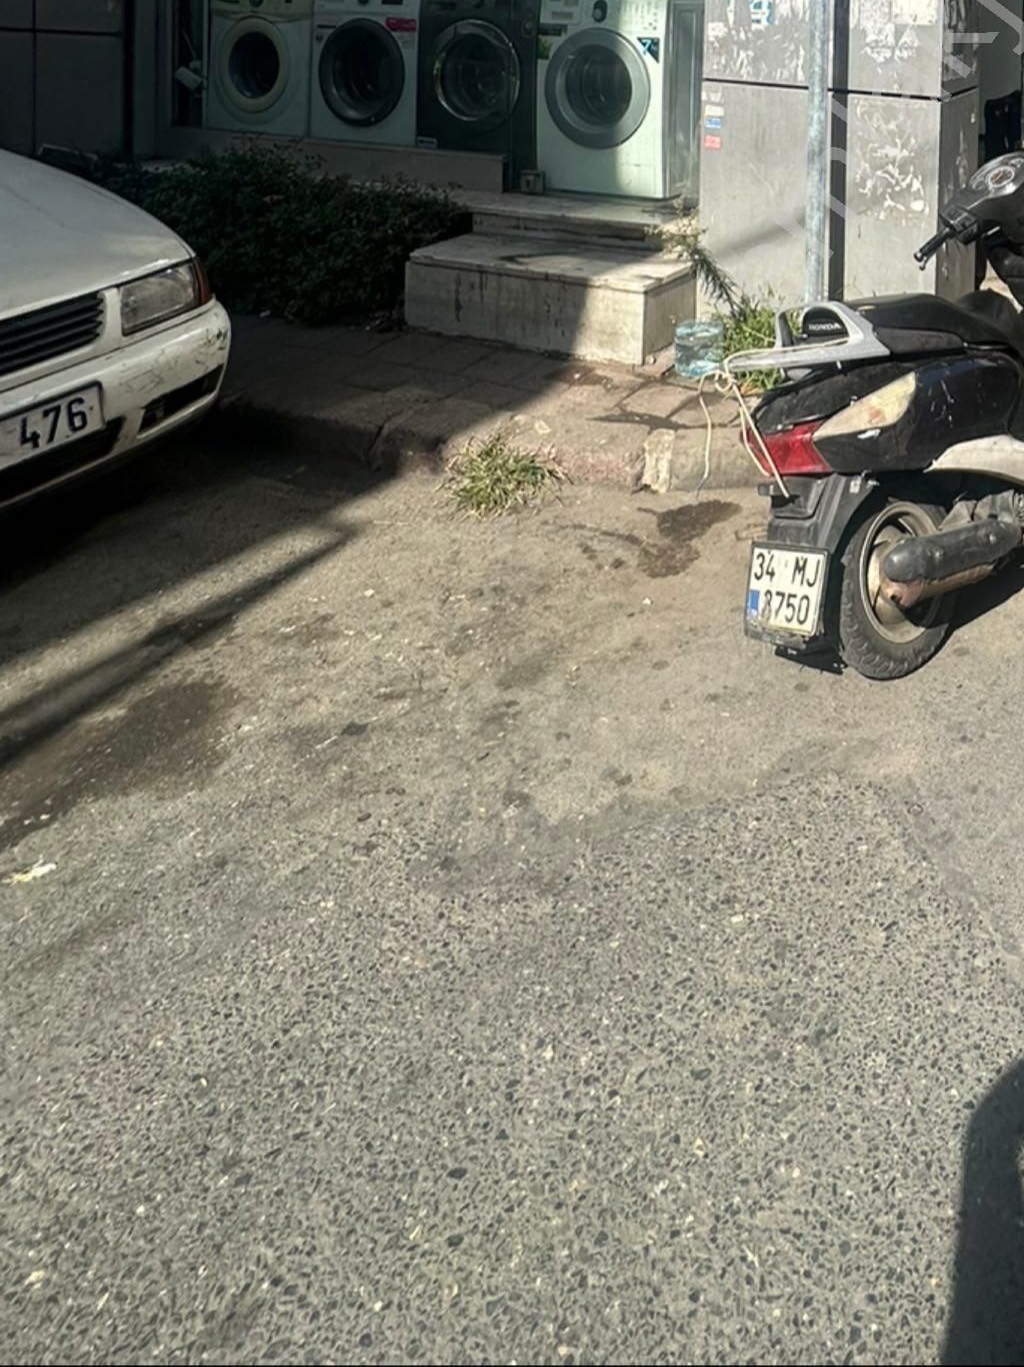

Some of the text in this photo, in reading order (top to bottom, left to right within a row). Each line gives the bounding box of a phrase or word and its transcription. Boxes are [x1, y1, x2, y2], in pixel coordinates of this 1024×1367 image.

[808, 322, 843, 332] HONDA
[20, 397, 88, 449] 476
[754, 551, 821, 588] 34 MJ
[761, 588, 811, 626] 8750
